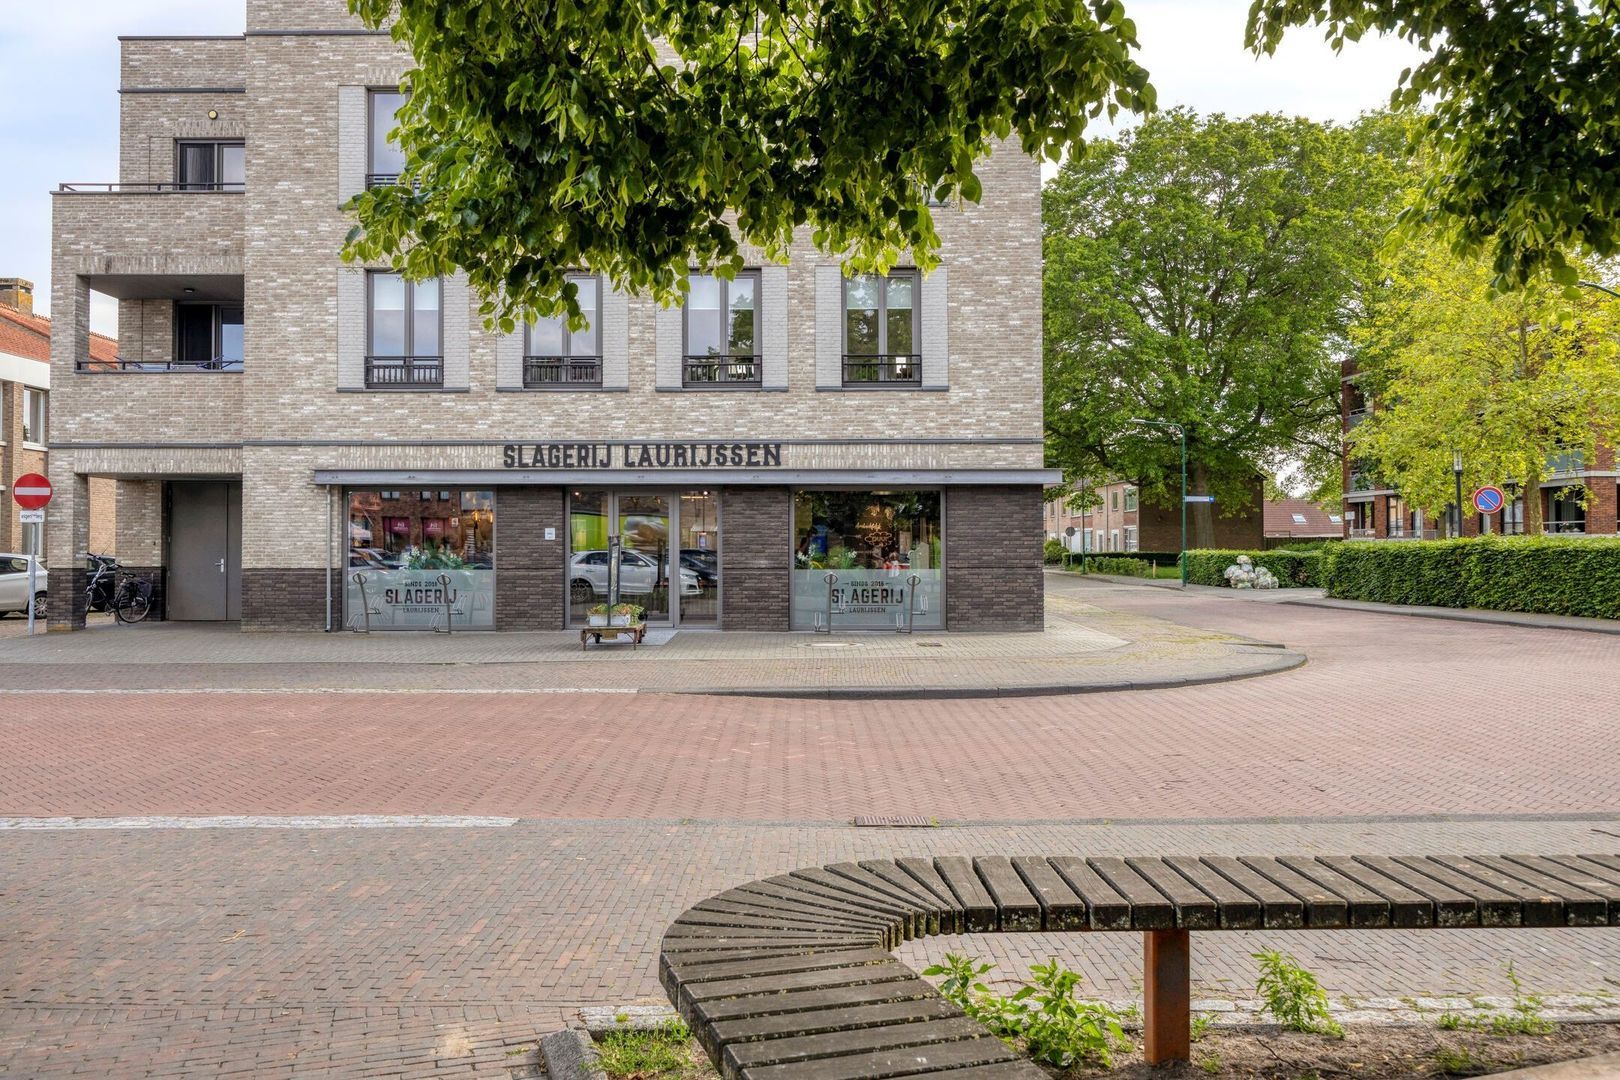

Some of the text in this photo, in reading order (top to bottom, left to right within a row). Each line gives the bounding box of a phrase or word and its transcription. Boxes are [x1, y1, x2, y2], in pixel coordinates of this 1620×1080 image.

[503, 444, 781, 468] SLAGERIJ LAURIJSSEN
[385, 589, 457, 604] SLAGERIJ
[831, 588, 904, 604] SLAGERIJ
